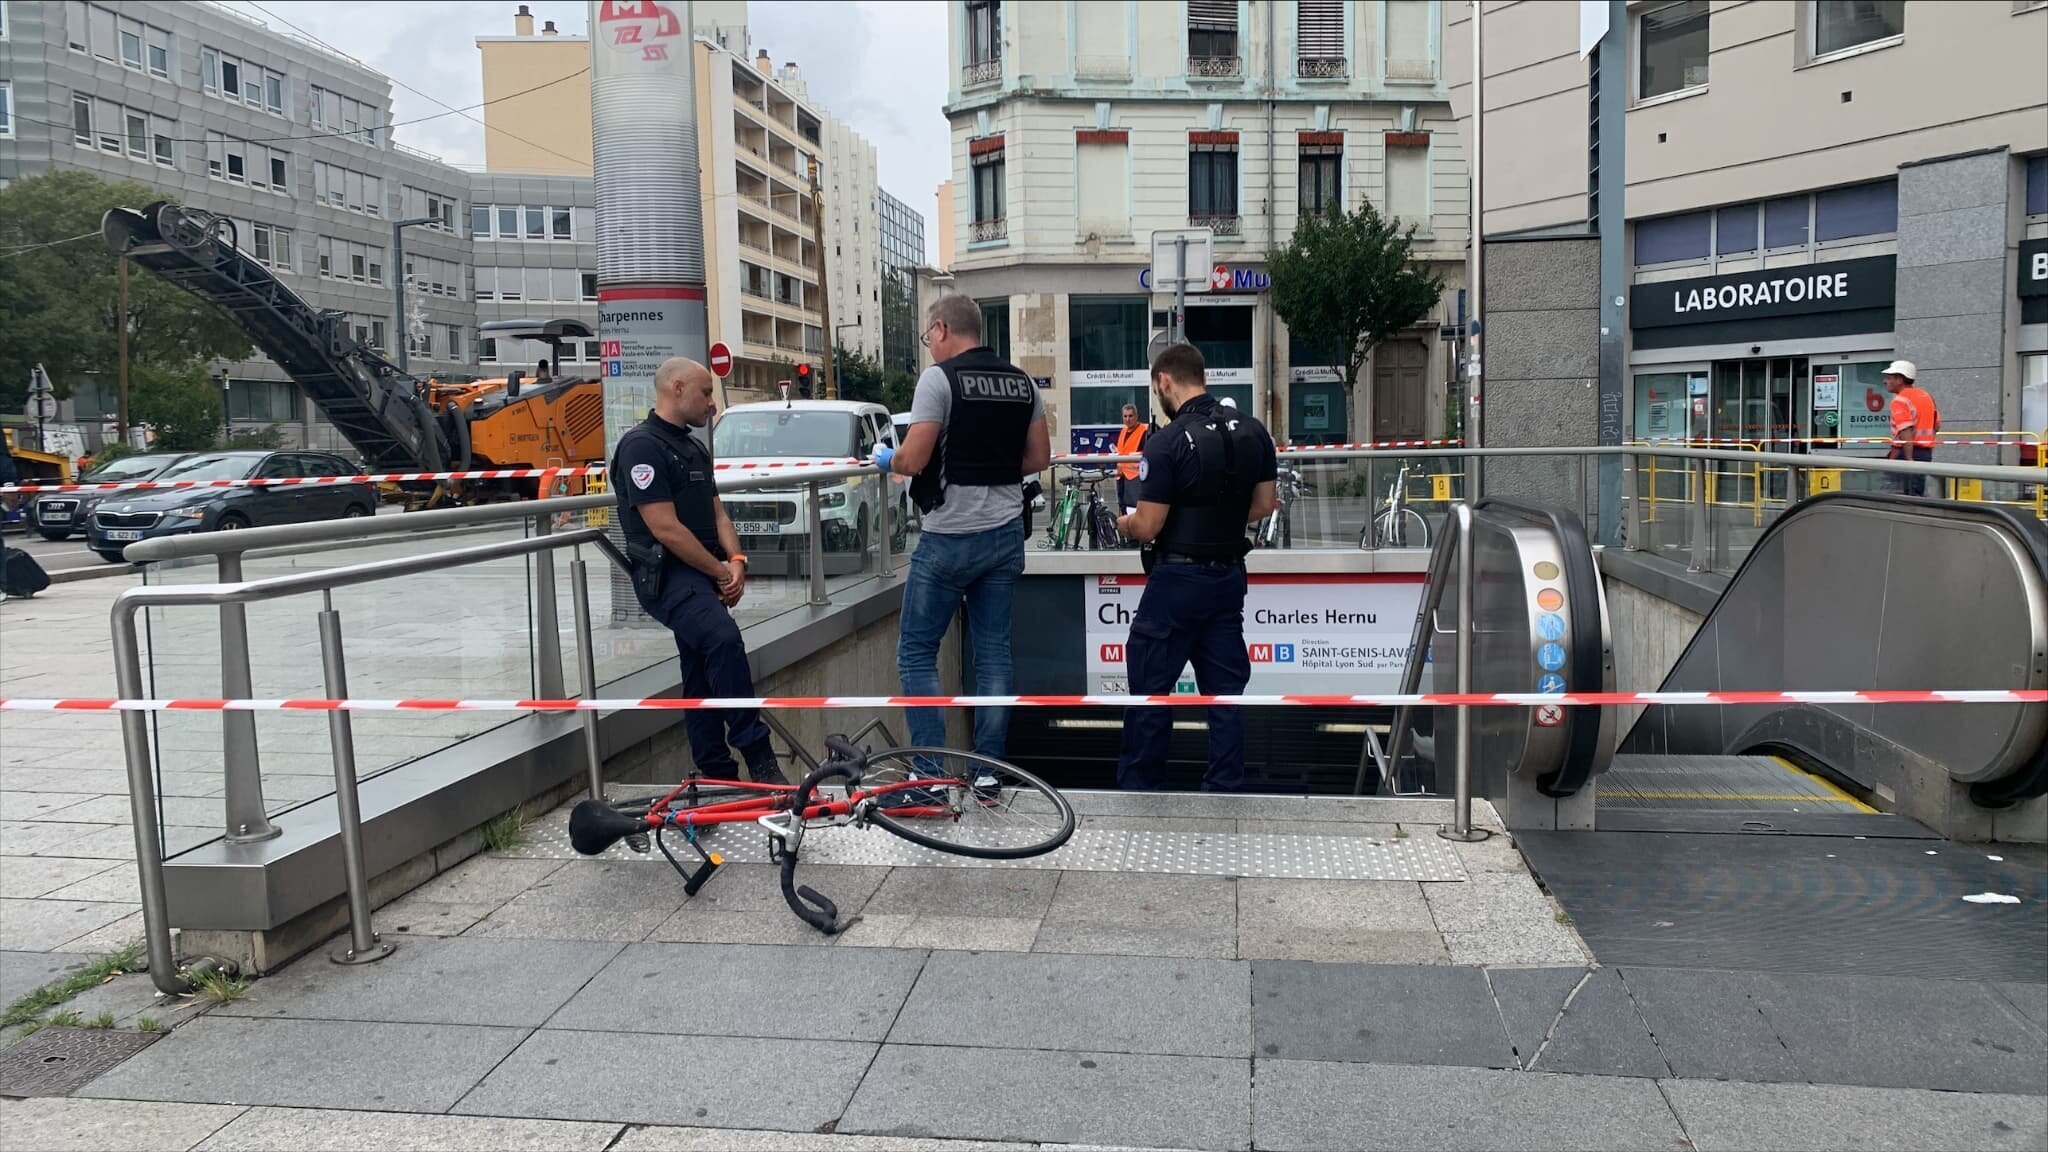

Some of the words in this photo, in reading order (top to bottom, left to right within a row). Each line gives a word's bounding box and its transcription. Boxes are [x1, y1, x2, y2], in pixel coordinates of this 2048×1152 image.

[1674, 272, 1849, 313] LABORATOIRE
[962, 375, 1028, 398] POLICE
[735, 522, 774, 533] S-959-JN
[1098, 603, 1138, 624] Ch
[1255, 609, 1318, 624] Charles
[1325, 609, 1377, 624] Hernu
[1105, 647, 1119, 660] M
[1254, 647, 1268, 660] M
[1280, 647, 1290, 660] B
[1302, 659, 1333, 670] Hôpital
[1335, 660, 1355, 670] Lyon
[1358, 660, 1374, 668] Sud
